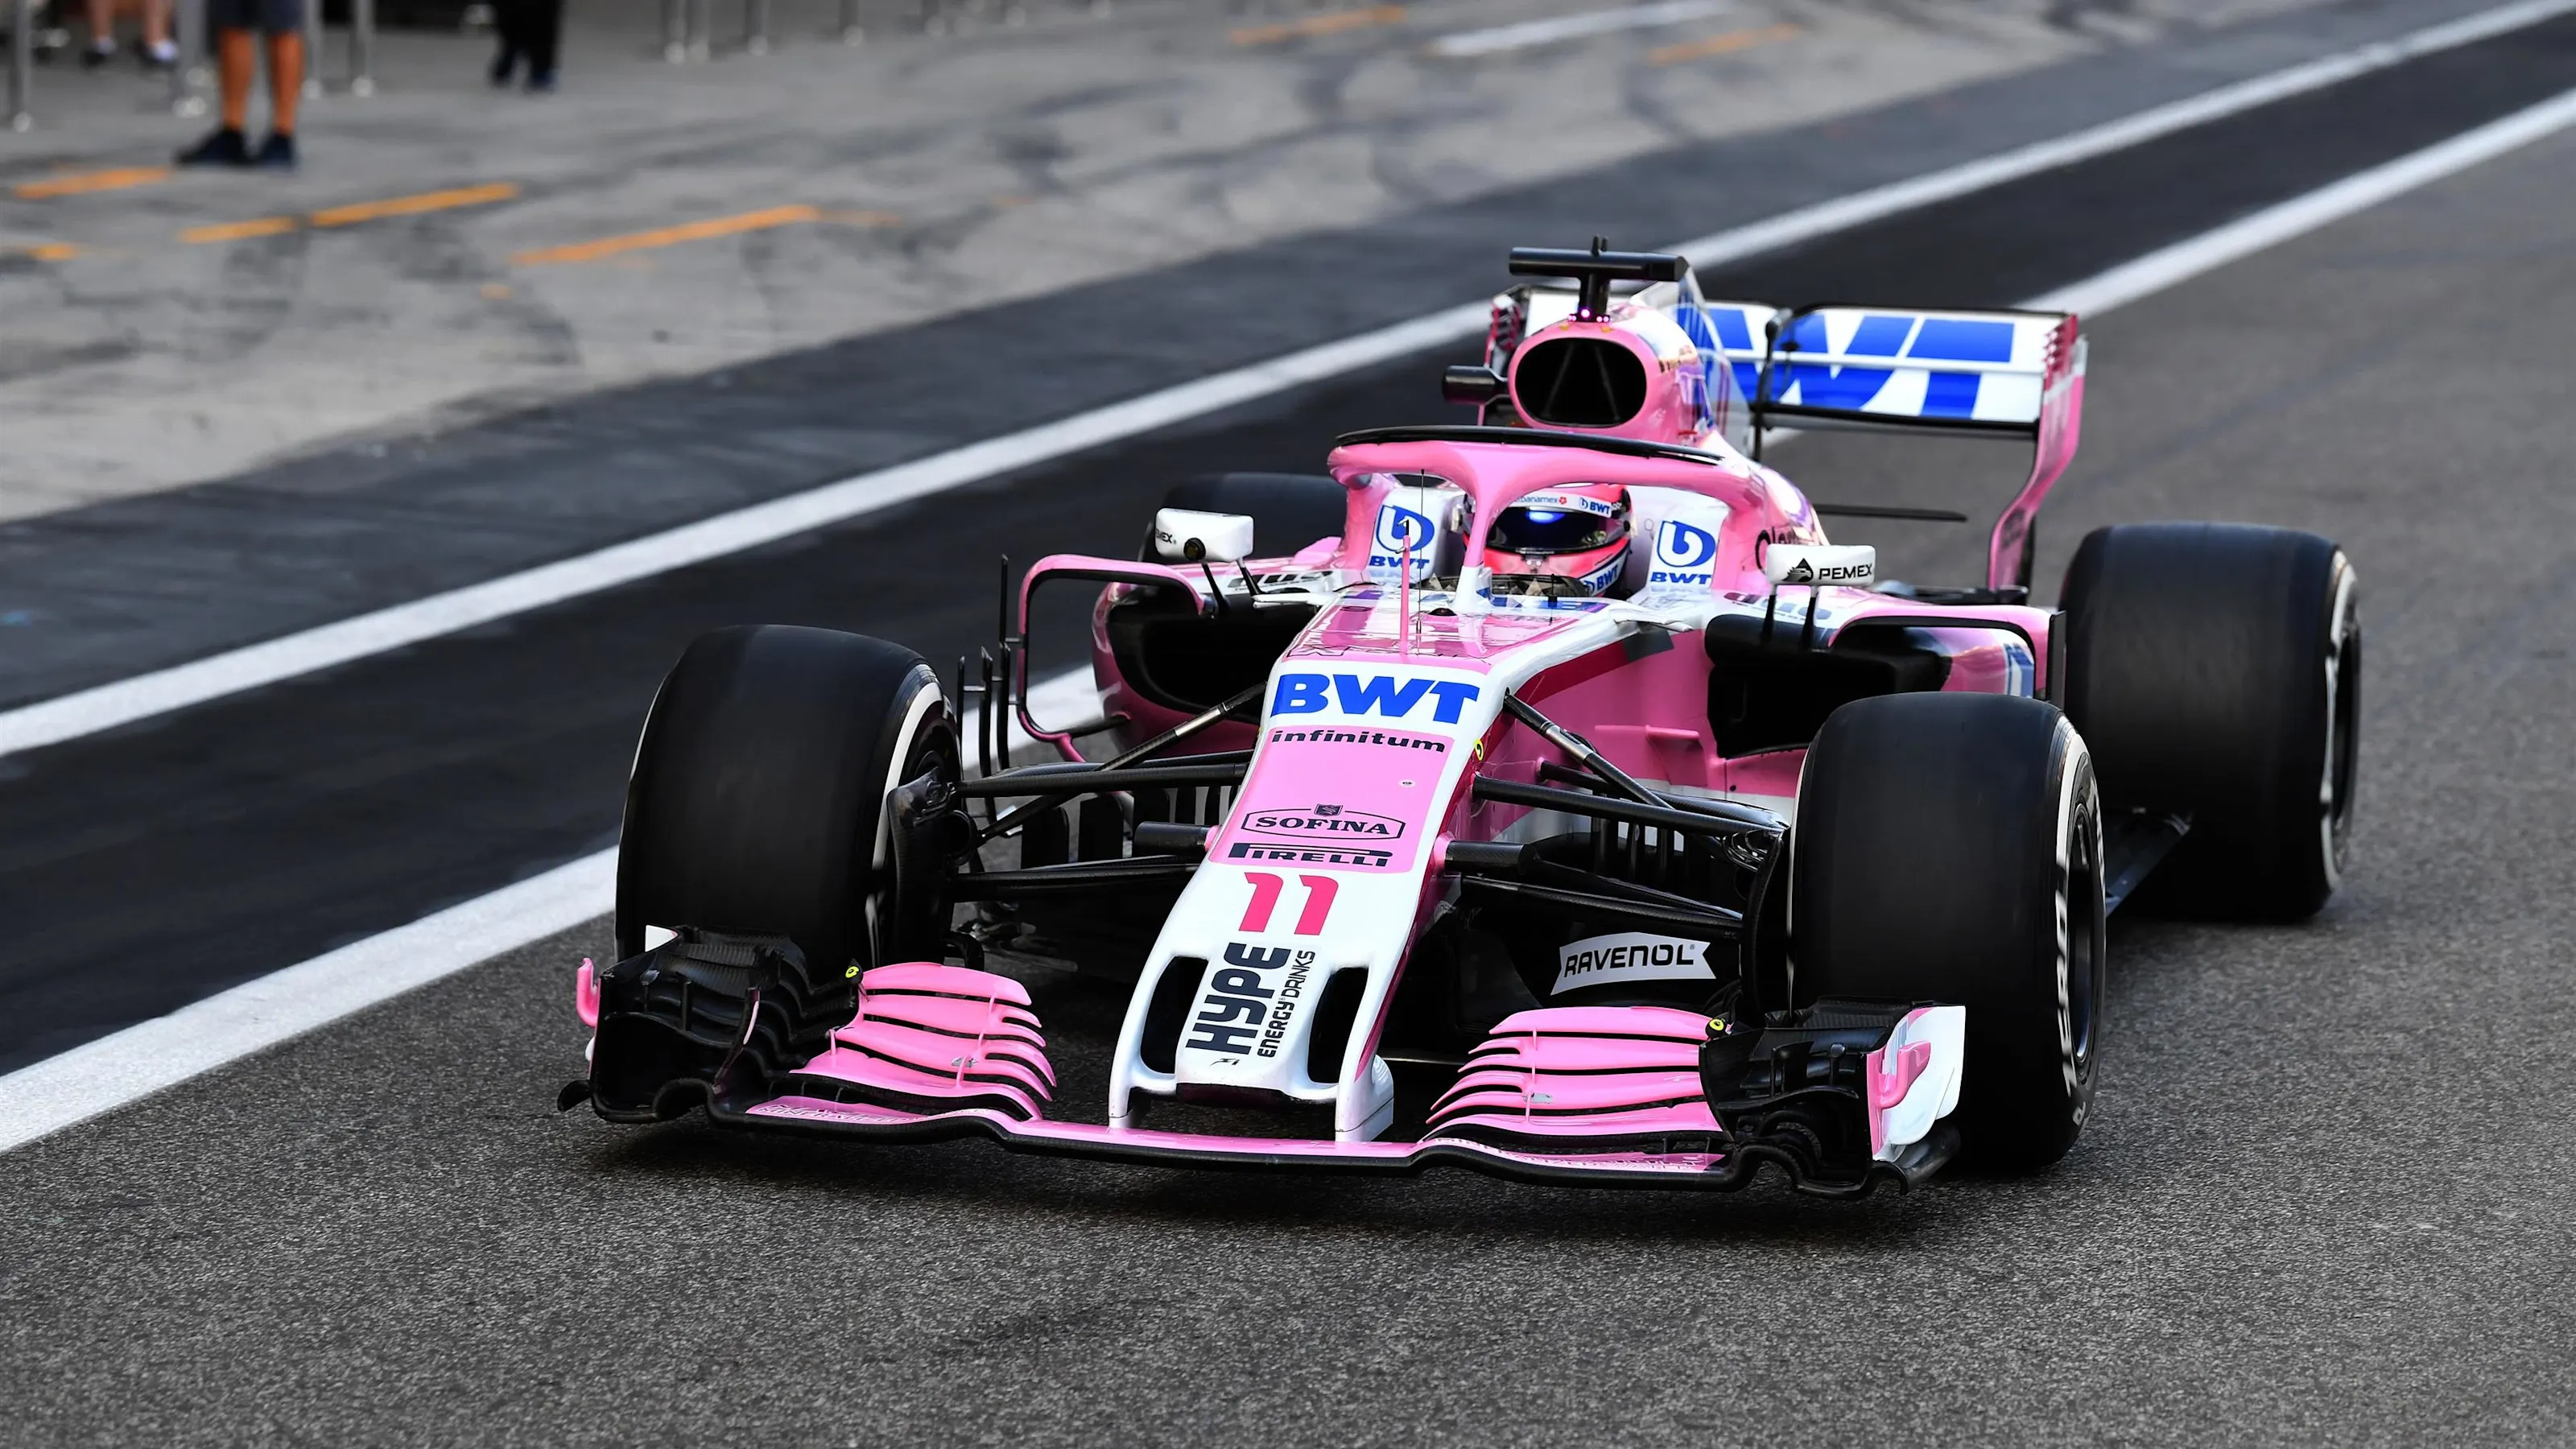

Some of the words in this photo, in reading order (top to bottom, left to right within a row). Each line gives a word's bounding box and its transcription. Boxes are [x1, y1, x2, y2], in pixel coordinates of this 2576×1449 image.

[1590, 502, 1610, 515] BWT
[1370, 555, 1430, 569] BWT
[1818, 564, 1872, 580] PEMEX
[1596, 564, 1618, 591] BWT
[1650, 572, 1711, 584] BWT
[1270, 674, 1480, 724] BWT
[1272, 730, 1444, 753] infinitum
[1256, 817, 1389, 835] SOFINA
[1228, 843, 1393, 867] PIRELLI
[1239, 872, 1339, 935] 11
[1564, 944, 1694, 977] RAVENOL
[1186, 942, 1291, 1055] HYPE
[1257, 1001, 1294, 1058] ENERGY
[1281, 950, 1315, 998] DRINKS
